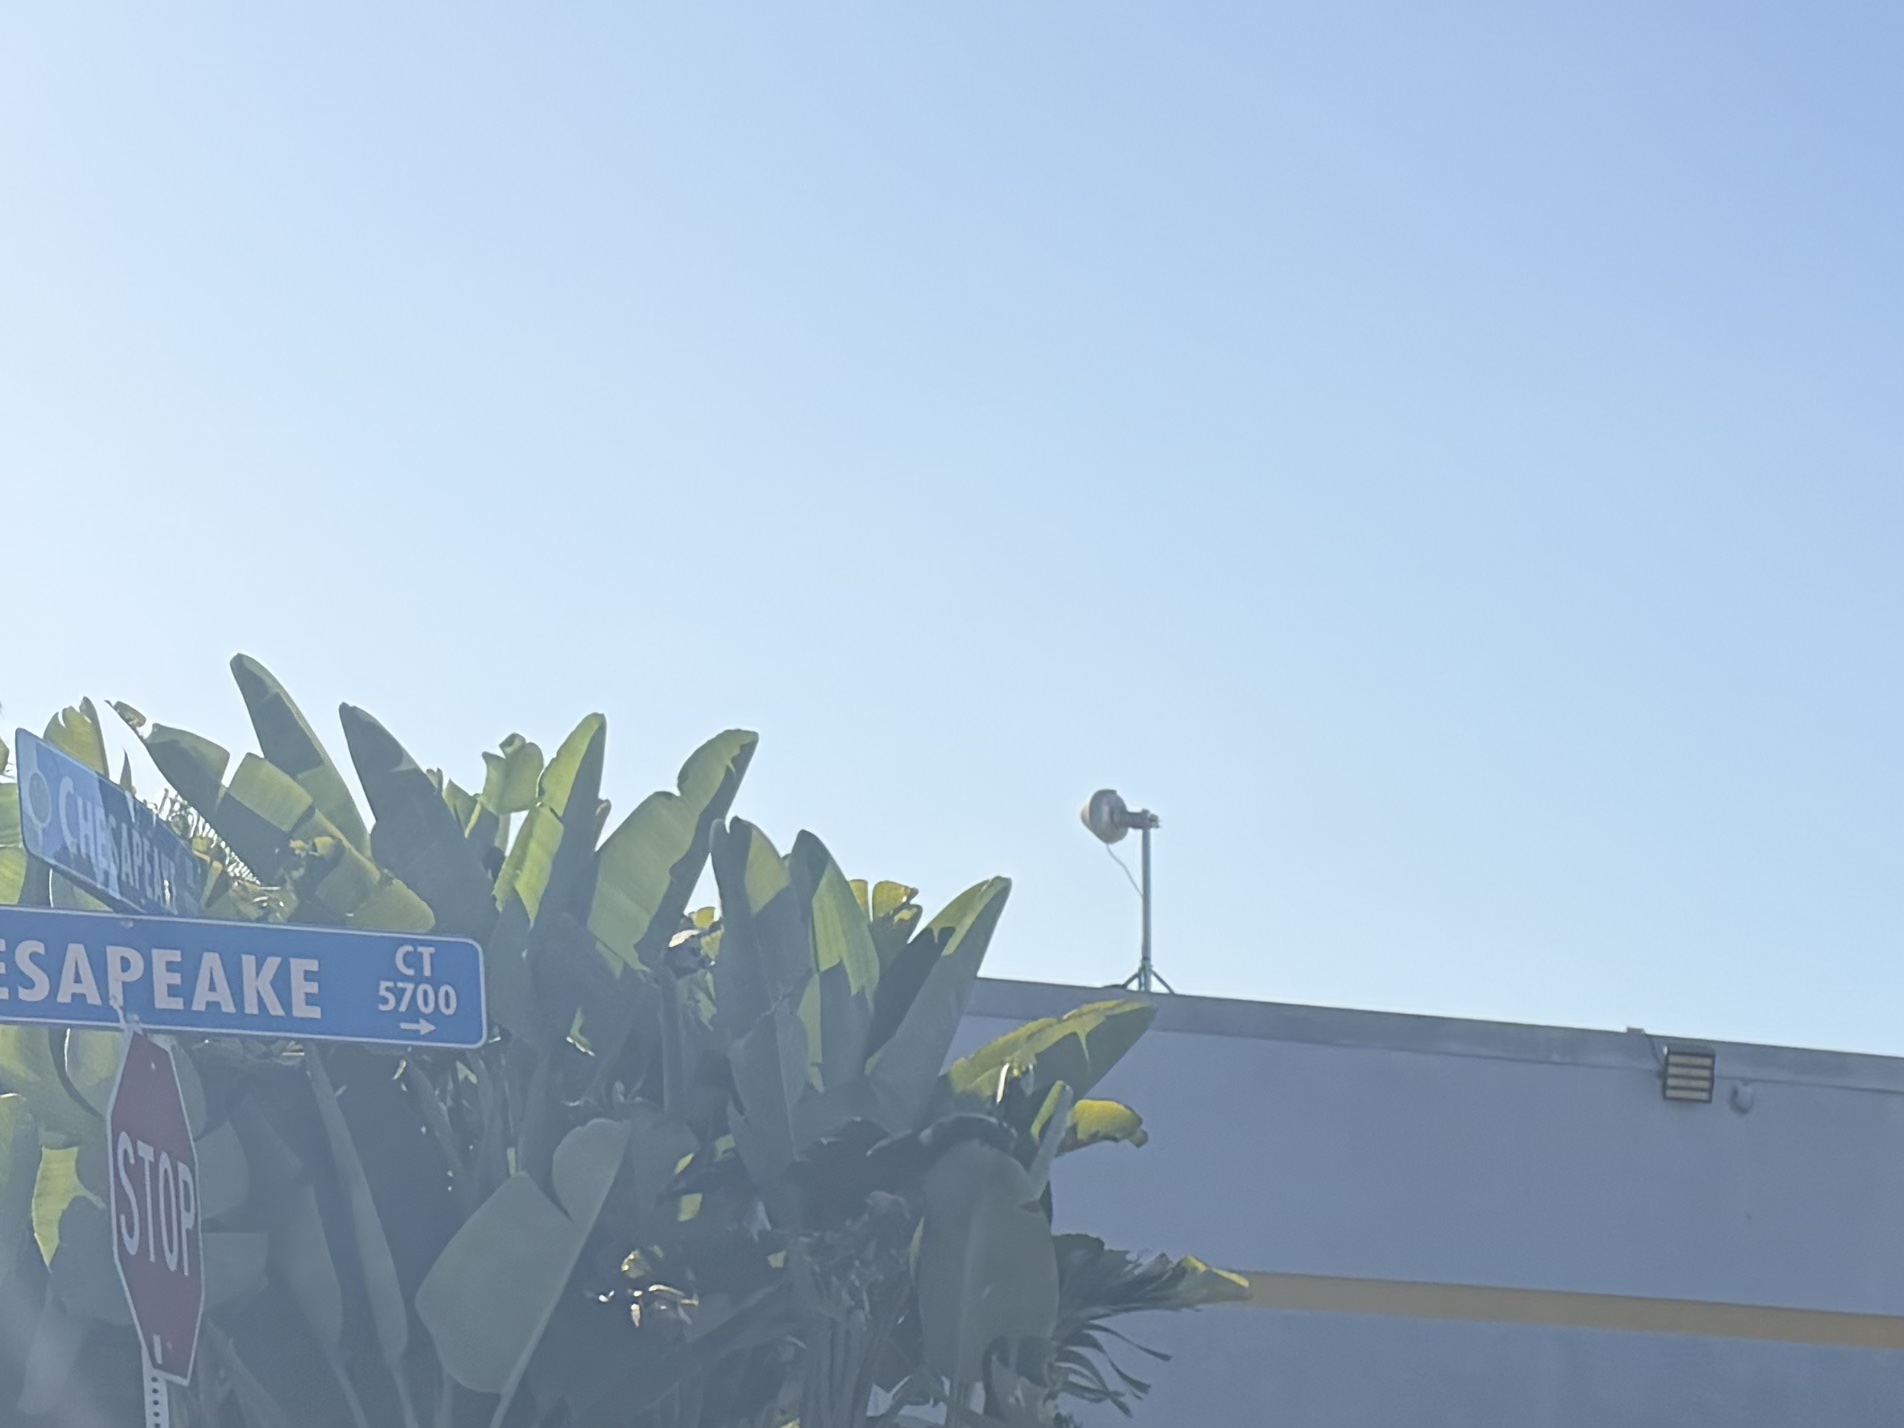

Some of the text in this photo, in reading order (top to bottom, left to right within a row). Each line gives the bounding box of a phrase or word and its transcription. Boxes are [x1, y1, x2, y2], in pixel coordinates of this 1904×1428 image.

[0, 938, 322, 1019] SAPEAKE
[395, 945, 436, 978] CT
[378, 981, 458, 1016] 5700
[117, 1131, 196, 1277] STOP
